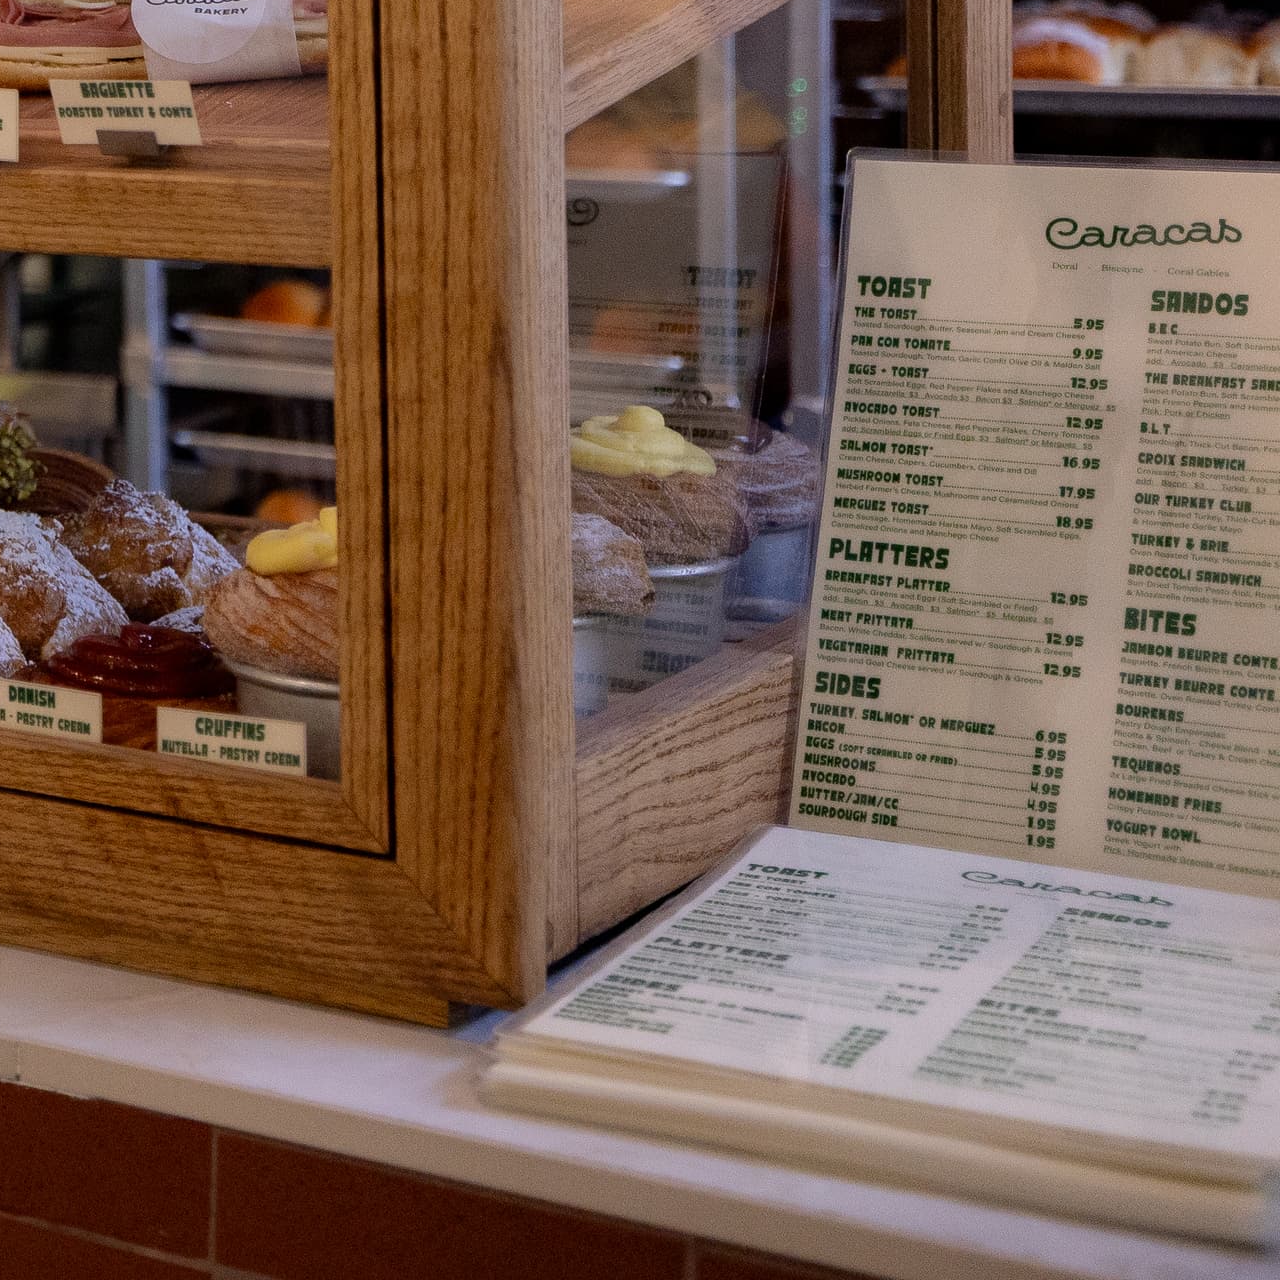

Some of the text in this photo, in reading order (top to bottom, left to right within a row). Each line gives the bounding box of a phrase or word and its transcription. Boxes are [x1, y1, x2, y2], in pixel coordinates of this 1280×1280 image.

[193, 6, 249, 17] BAKERY
[79, 81, 156, 99] BAGUETTE
[58, 106, 194, 119] ROASTED TURKEY & COMTE
[1045, 217, 1243, 250] Caracas
[1052, 262, 1079, 271] Doral
[857, 275, 932, 300] TOAST
[1150, 289, 1250, 317] SANDOS
[854, 306, 1105, 331] THE TOAST 5.95
[851, 334, 1104, 361] PAN CON TOMATE 9.95
[848, 363, 1108, 391] EGGS TOAST 12.95
[1145, 372, 1246, 390] THE BREAKFAST
[844, 401, 1104, 430] AVOCADO TOAST 12.95
[839, 439, 886, 454] SALMON
[1062, 456, 1101, 470] 16.95
[1138, 452, 1246, 471] CROIX SANDWICH
[837, 468, 1096, 500] MUSHROOM TOAST 17.95
[834, 496, 1094, 531] MERGUEZ TOAST 18.95
[1134, 492, 1252, 513] OUR TURKEY CLUB
[829, 538, 950, 570] PLATTERS
[1131, 533, 1181, 549] TURKEY
[1200, 539, 1230, 553] BRIE
[825, 569, 1089, 607] BREAKFAST PLATTER 12.95
[1128, 563, 1262, 588] BROCCOLI SANDWICH
[820, 608, 1084, 647] MEAT FRITTATA 12.95
[1124, 607, 1198, 637] BITES
[818, 638, 1082, 679] VEGETARIAN FRITTATA 12.95
[1121, 640, 1173, 659] JAMBON
[1177, 647, 1228, 665] BEURRE
[8, 685, 57, 709] DANISH
[815, 671, 881, 700] SIDES
[16, 710, 55, 730] PASTRY
[57, 718, 91, 736] CREAM
[1115, 703, 1184, 723] BOUREKAS
[195, 717, 266, 742] CRUFFINS
[807, 719, 846, 735] BACON
[919, 716, 936, 729] OR
[940, 718, 996, 737] MERGUEZ
[161, 738, 302, 768] NUTELLA PASTRY CREAM
[805, 735, 835, 751] EGGS
[866, 745, 913, 761] SCRAMBLED
[915, 752, 928, 763] OR
[804, 752, 876, 772] MUSHROOMS
[801, 769, 856, 787] AVOCADO
[800, 785, 899, 810] BUTTER/JAM/CC
[1108, 786, 1223, 814] HOMEMADE FRIES
[798, 802, 899, 827] SOURDOUGH SIDE
[1106, 817, 1201, 845] YOGURT BOWL
[748, 863, 830, 879] TOAST
[961, 870, 1175, 908] Caracas
[1064, 906, 1172, 929] SANDOS
[653, 935, 794, 962] PLATTERS
[603, 974, 683, 993] SIDES
